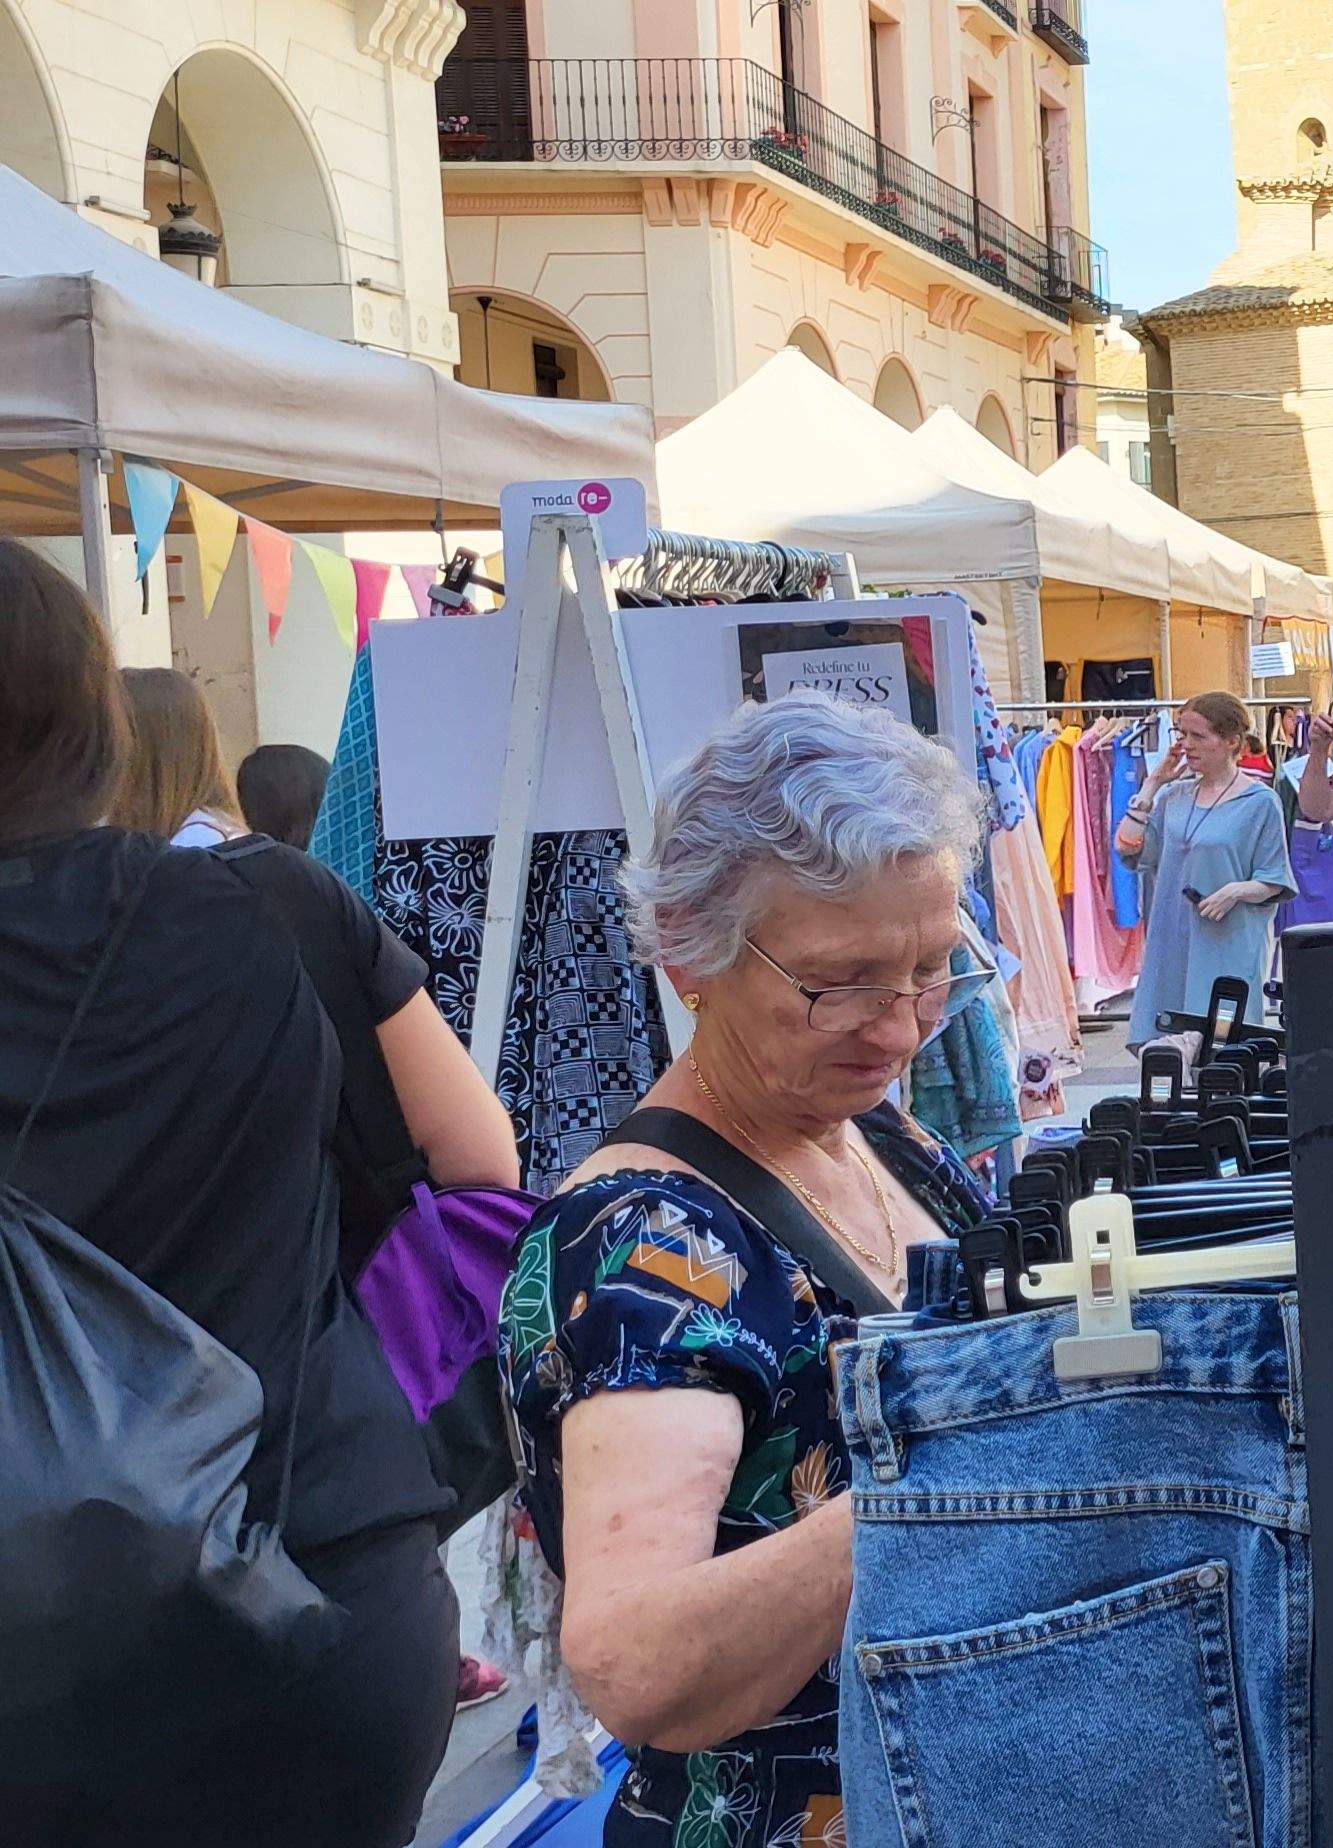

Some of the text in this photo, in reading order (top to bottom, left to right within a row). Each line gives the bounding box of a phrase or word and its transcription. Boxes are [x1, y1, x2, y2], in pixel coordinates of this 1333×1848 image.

[531, 493, 574, 507] moda
[803, 660, 871, 674] Redefine tu
